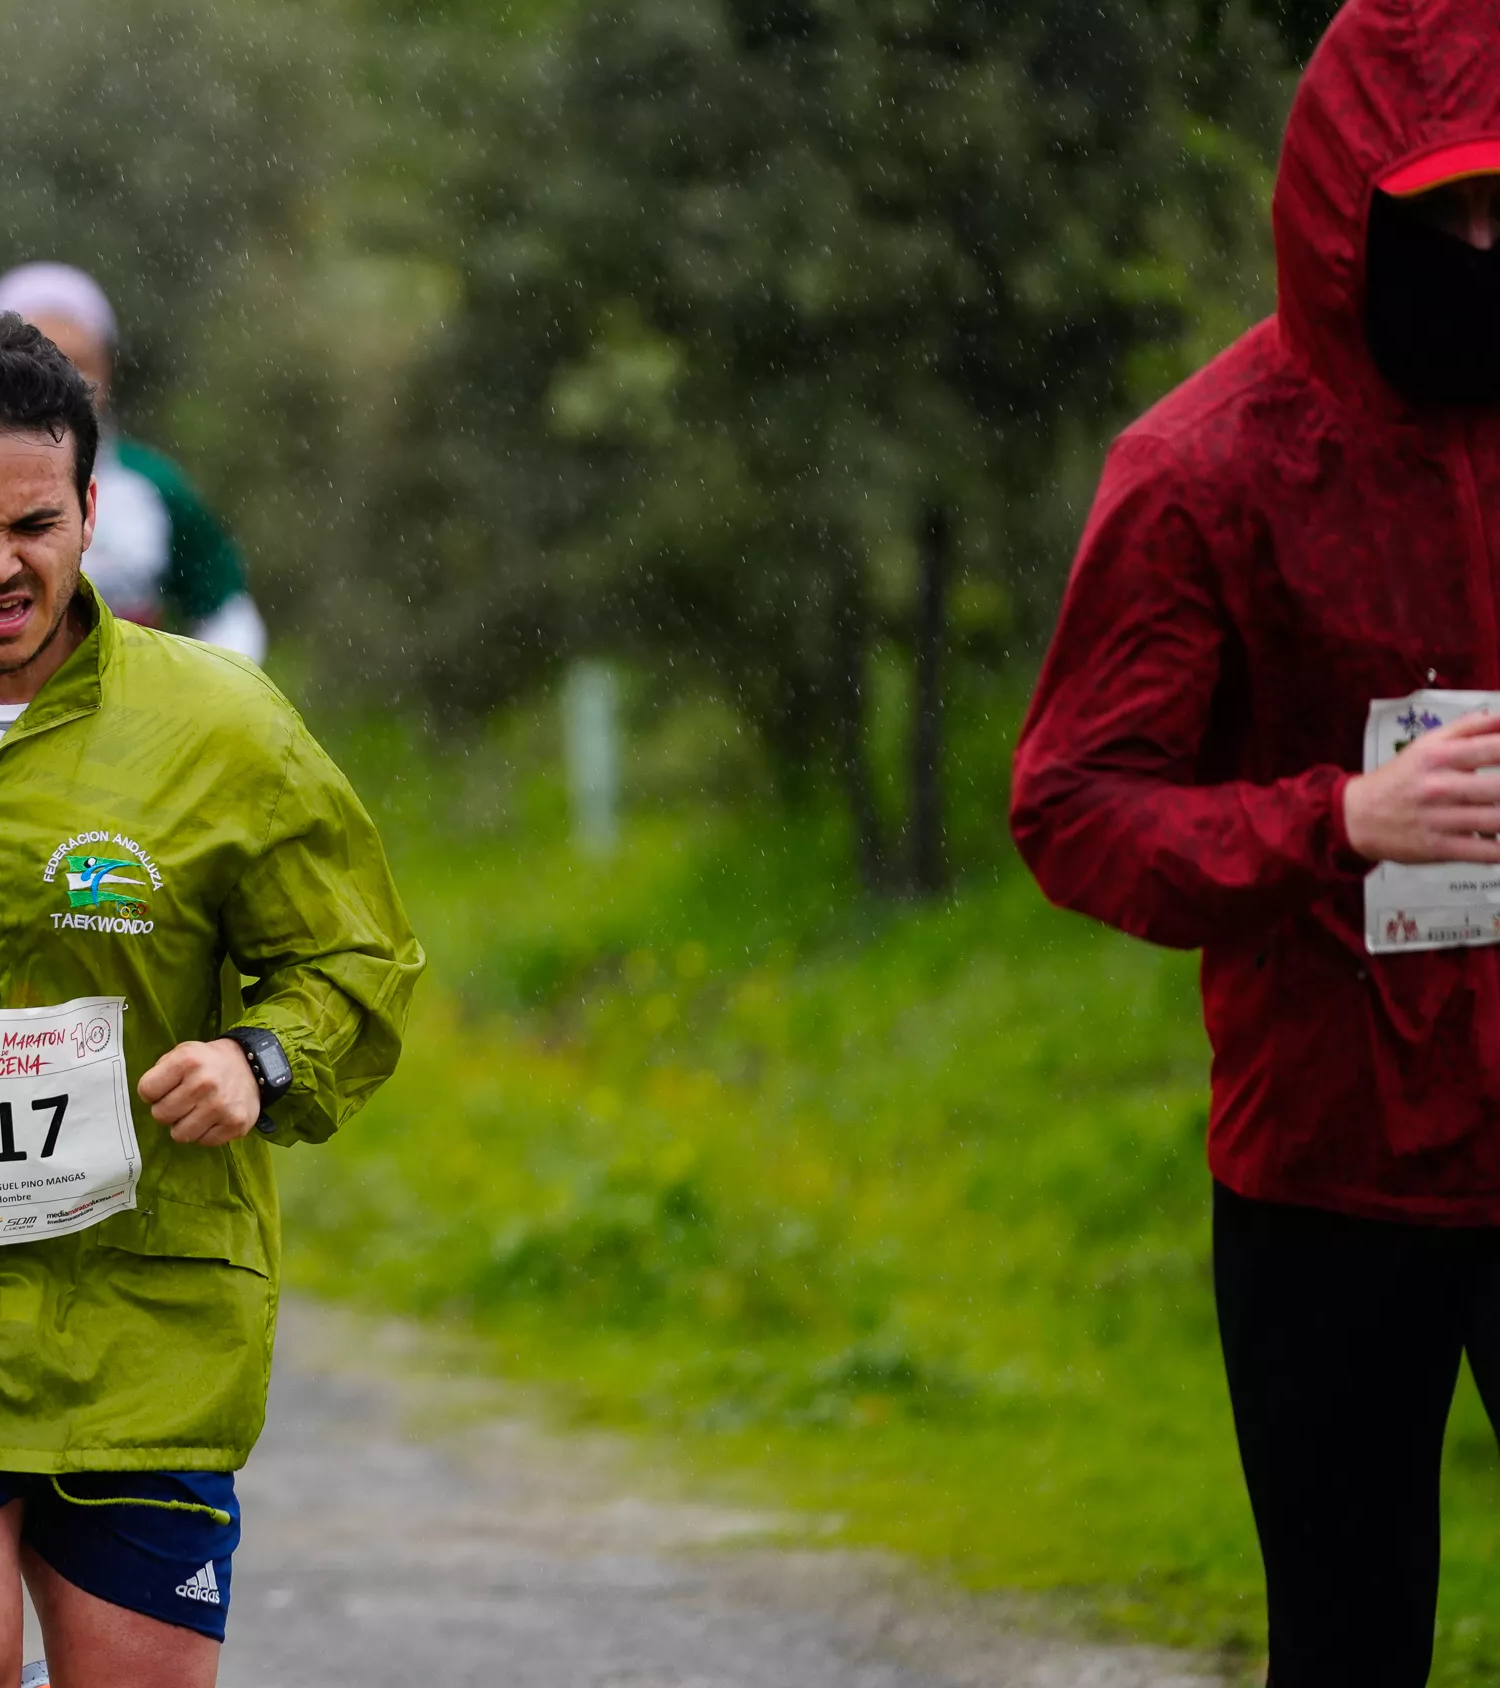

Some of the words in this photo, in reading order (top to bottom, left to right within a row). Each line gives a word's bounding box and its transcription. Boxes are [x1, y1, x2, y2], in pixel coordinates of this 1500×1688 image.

[43, 830, 109, 883] FEDERACION
[112, 833, 164, 892] ANDALUZA
[50, 913, 154, 935] TAEKWONDO
[21, 1179, 44, 1189] PINO
[46, 1172, 86, 1186] MANGAS
[175, 1584, 220, 1604] adidas
